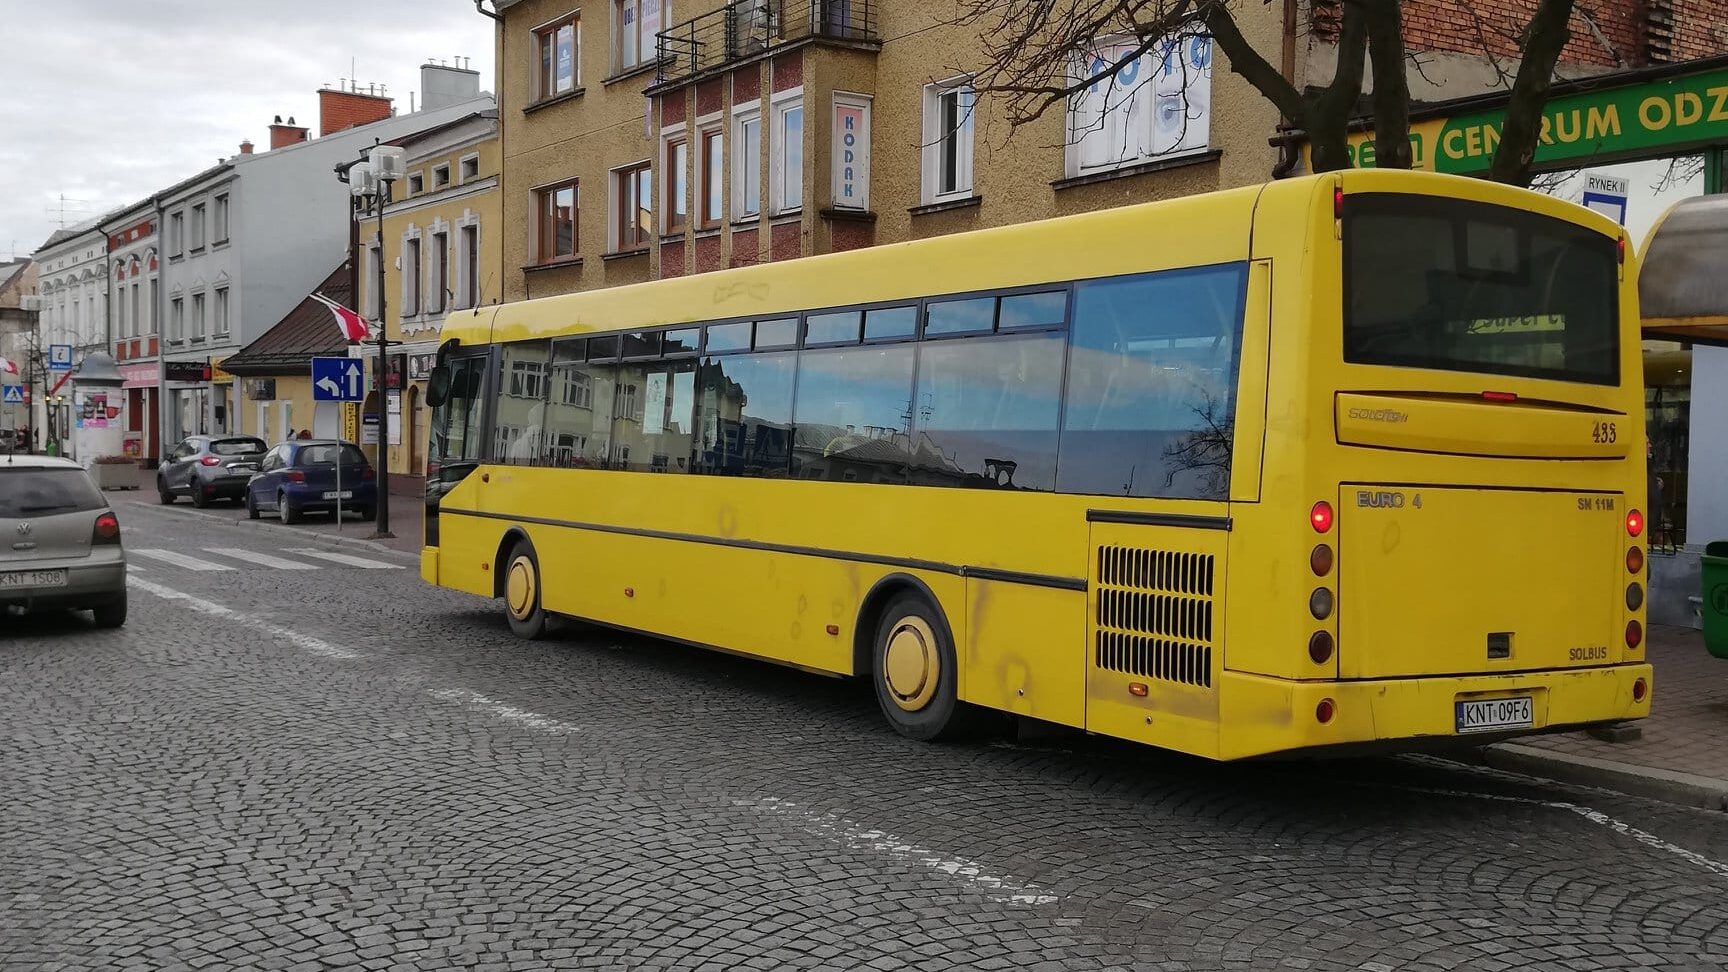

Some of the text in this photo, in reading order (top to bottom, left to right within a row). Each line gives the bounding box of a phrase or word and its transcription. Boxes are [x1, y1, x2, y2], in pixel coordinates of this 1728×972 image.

[1442, 104, 1621, 159] CENRUM
[844, 116, 855, 197] KODAK
[1589, 177, 1618, 192] RYNEK
[1357, 490, 1422, 509] EURO 4
[1569, 647, 1607, 660] SOLBUS
[1466, 701, 1528, 724] KNT 09F6
